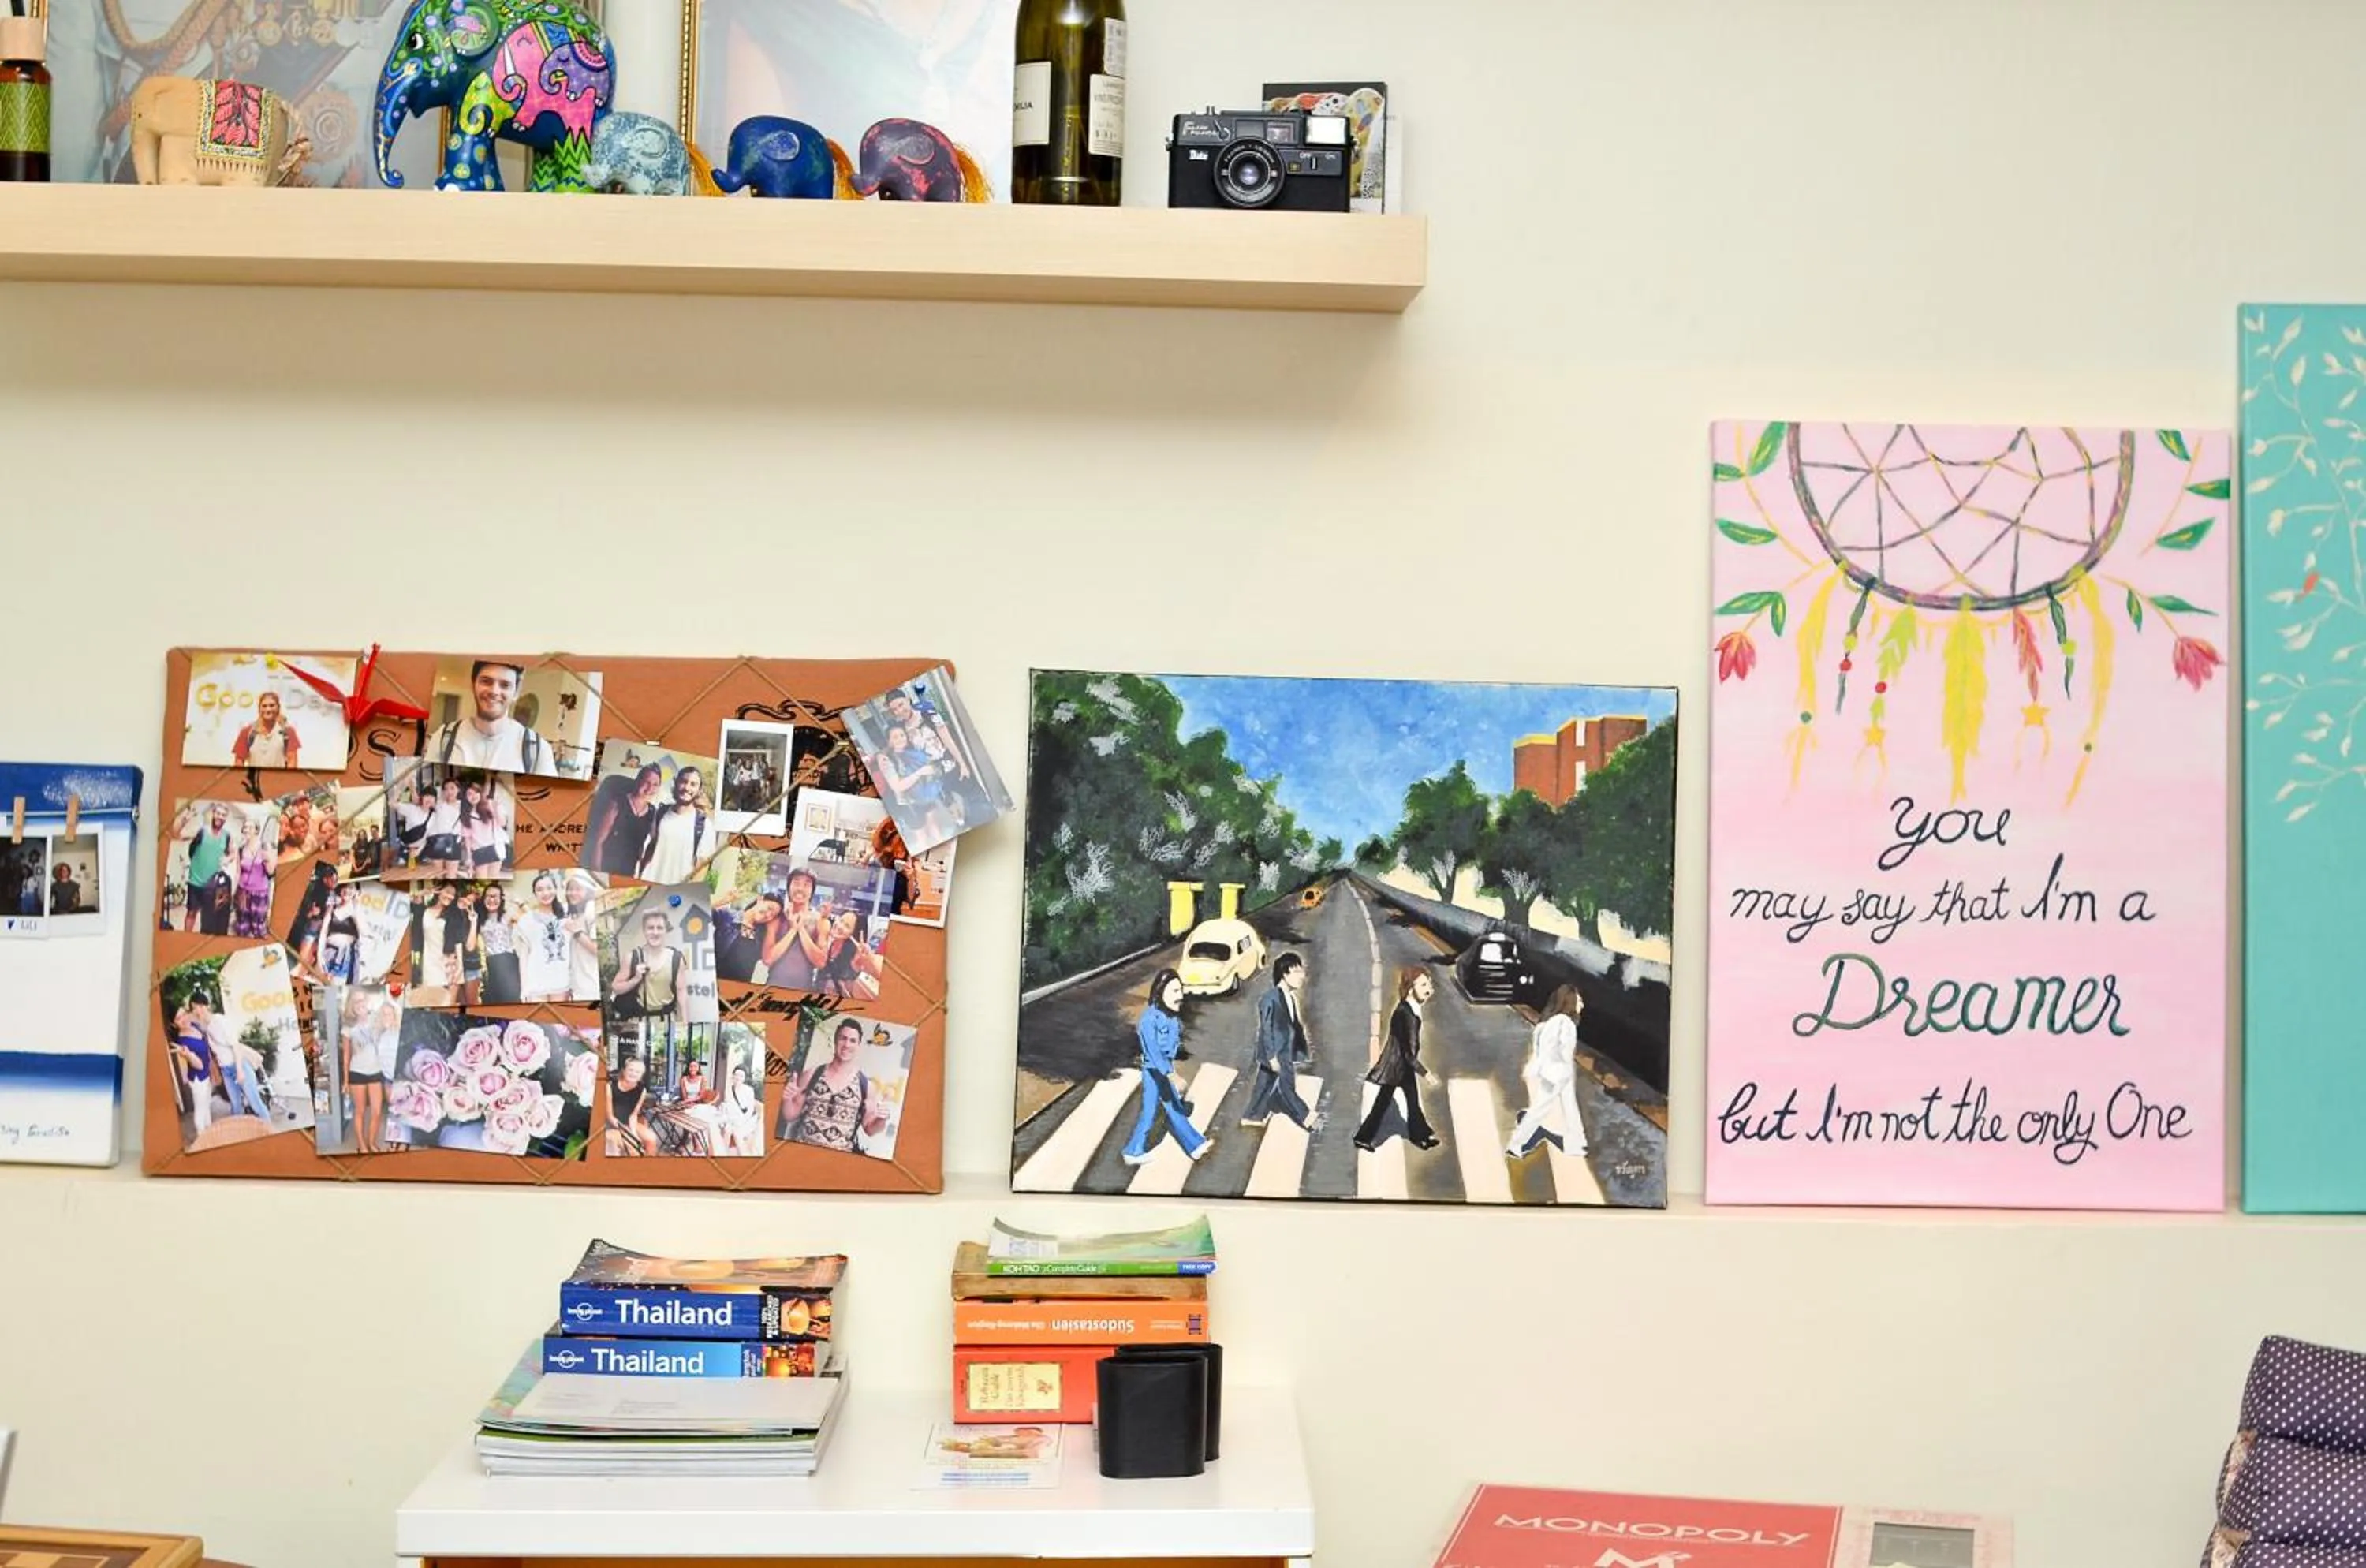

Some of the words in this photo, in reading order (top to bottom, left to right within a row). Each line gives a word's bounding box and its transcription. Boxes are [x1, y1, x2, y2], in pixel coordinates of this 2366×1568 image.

[1730, 888, 1834, 944] may
[1841, 888, 1916, 945] say
[1920, 877, 2010, 927] that
[2021, 853, 2098, 923] I'm
[2119, 890, 2157, 923] a
[1792, 953, 2131, 1038] Dreamer
[1717, 1081, 1798, 1145] but
[1879, 1085, 1942, 1144] not
[1942, 1077, 2010, 1144] the
[2017, 1089, 2099, 1167] only
[2106, 1081, 2194, 1141] One
[614, 1297, 733, 1327] Thailand
[591, 1347, 705, 1375] Thailand
[1494, 1513, 1812, 1547] MONOPOLY
